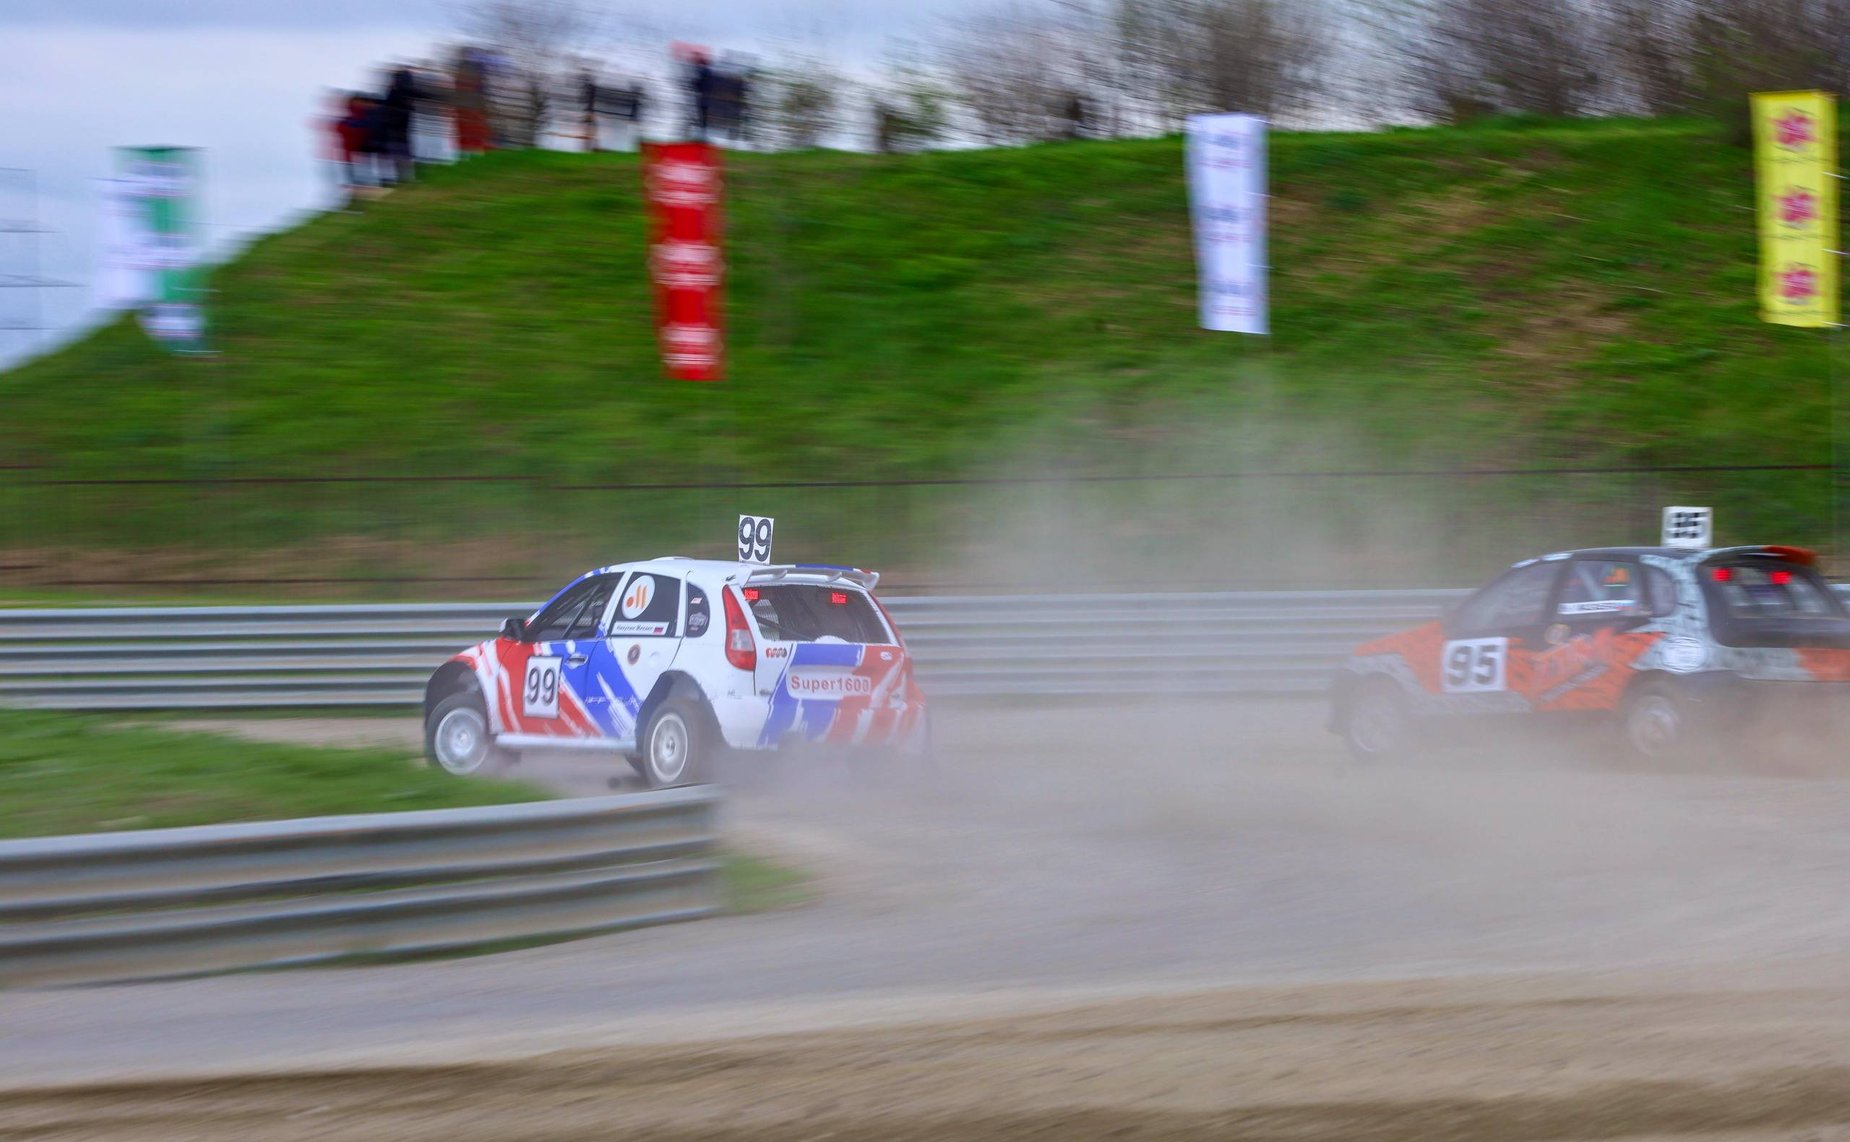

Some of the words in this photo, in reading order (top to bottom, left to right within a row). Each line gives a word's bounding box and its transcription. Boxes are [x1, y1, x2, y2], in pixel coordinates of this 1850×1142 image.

[739, 516, 772, 562] 99
[790, 675, 871, 694] Super1600
[1447, 644, 1500, 687] 95
[526, 667, 556, 706] 99
